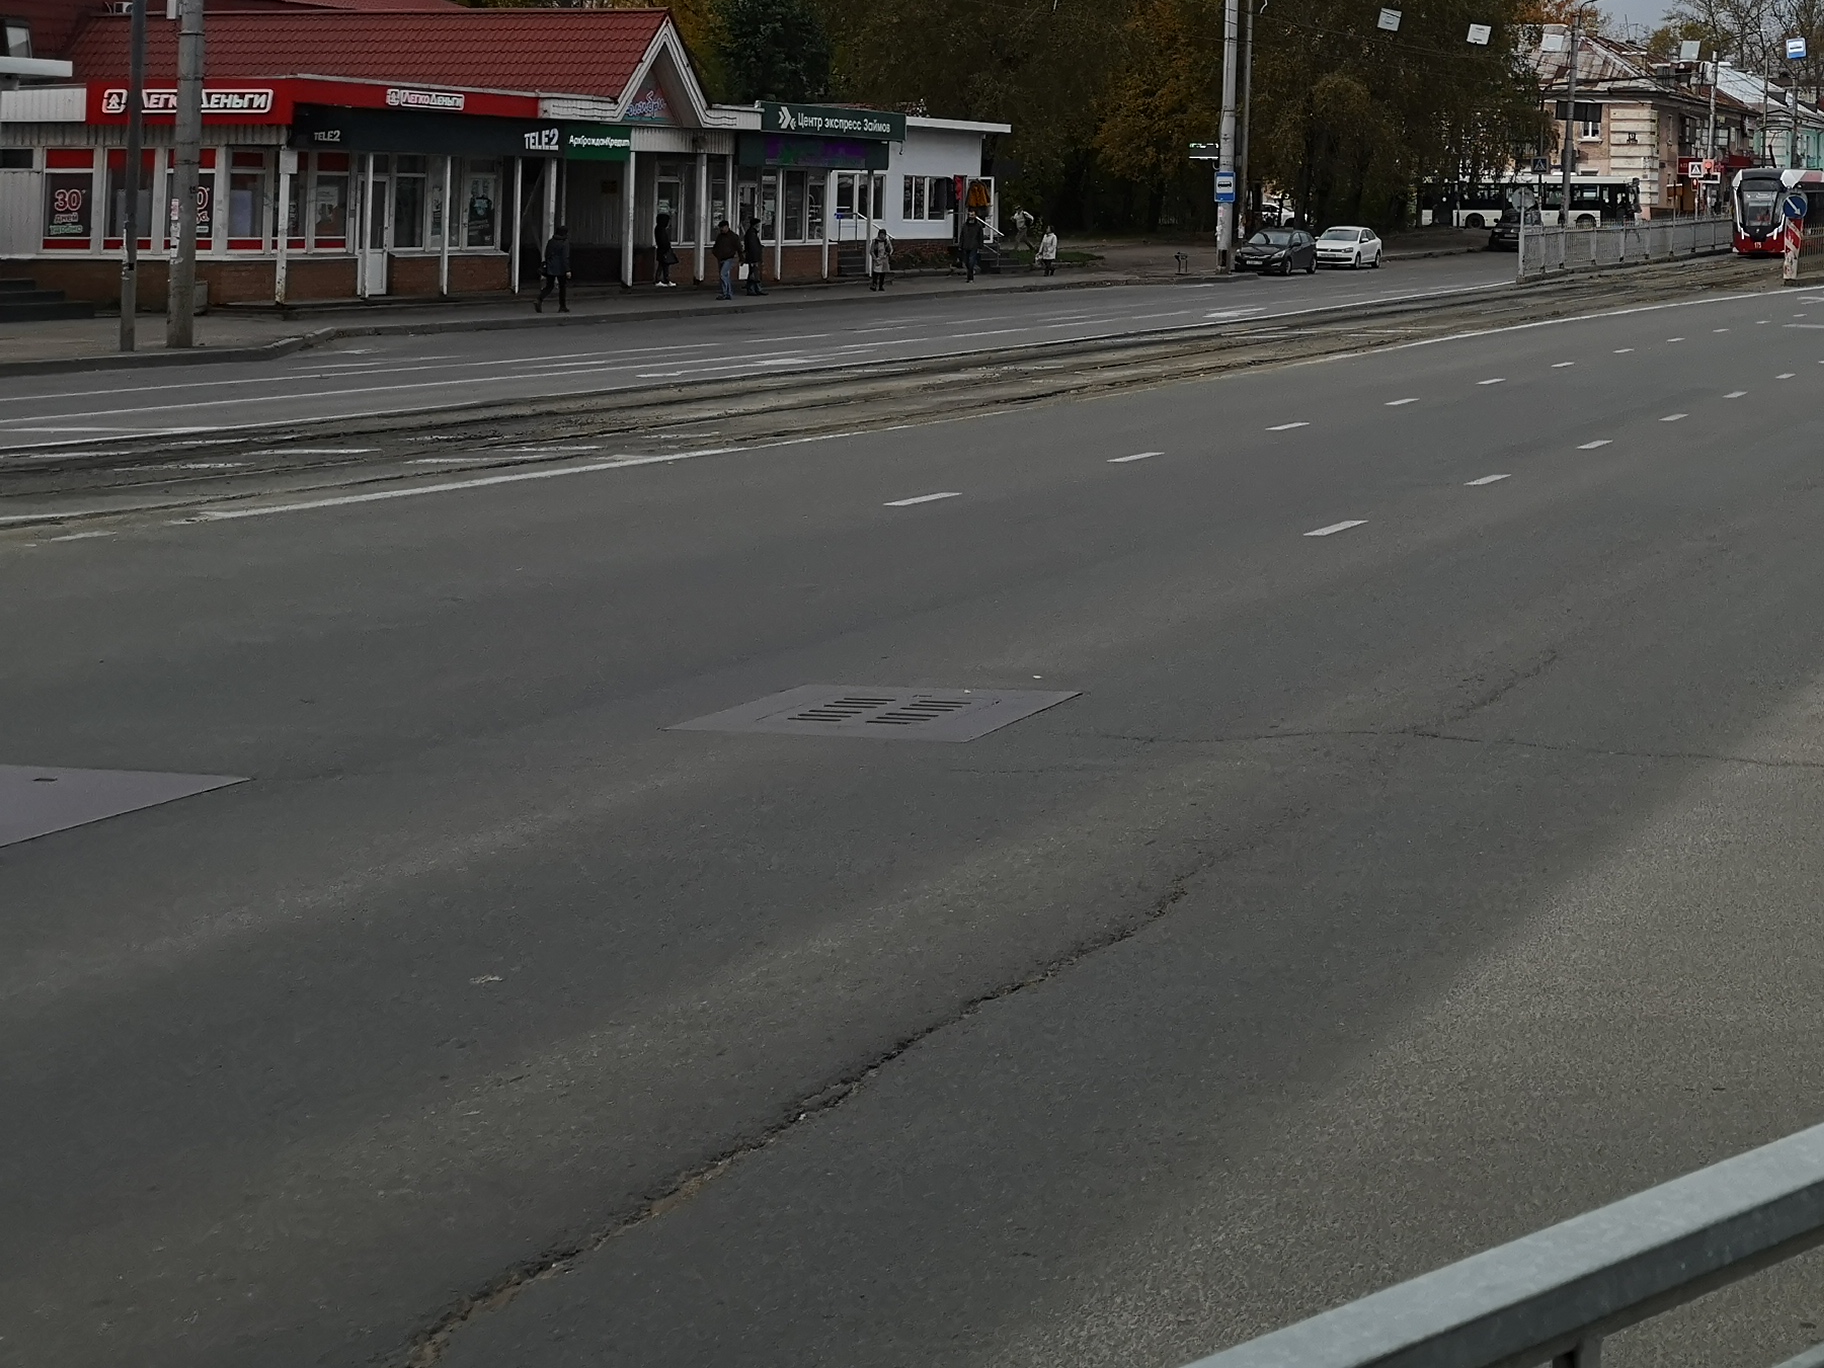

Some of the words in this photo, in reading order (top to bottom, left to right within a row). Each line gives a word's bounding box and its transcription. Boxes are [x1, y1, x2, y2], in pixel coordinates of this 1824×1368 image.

[798, 112, 823, 131] Центр
[824, 117, 862, 132] экспресс
[863, 118, 891, 133] Займов
[314, 130, 341, 142] TELE2
[524, 128, 559, 151] TELE2
